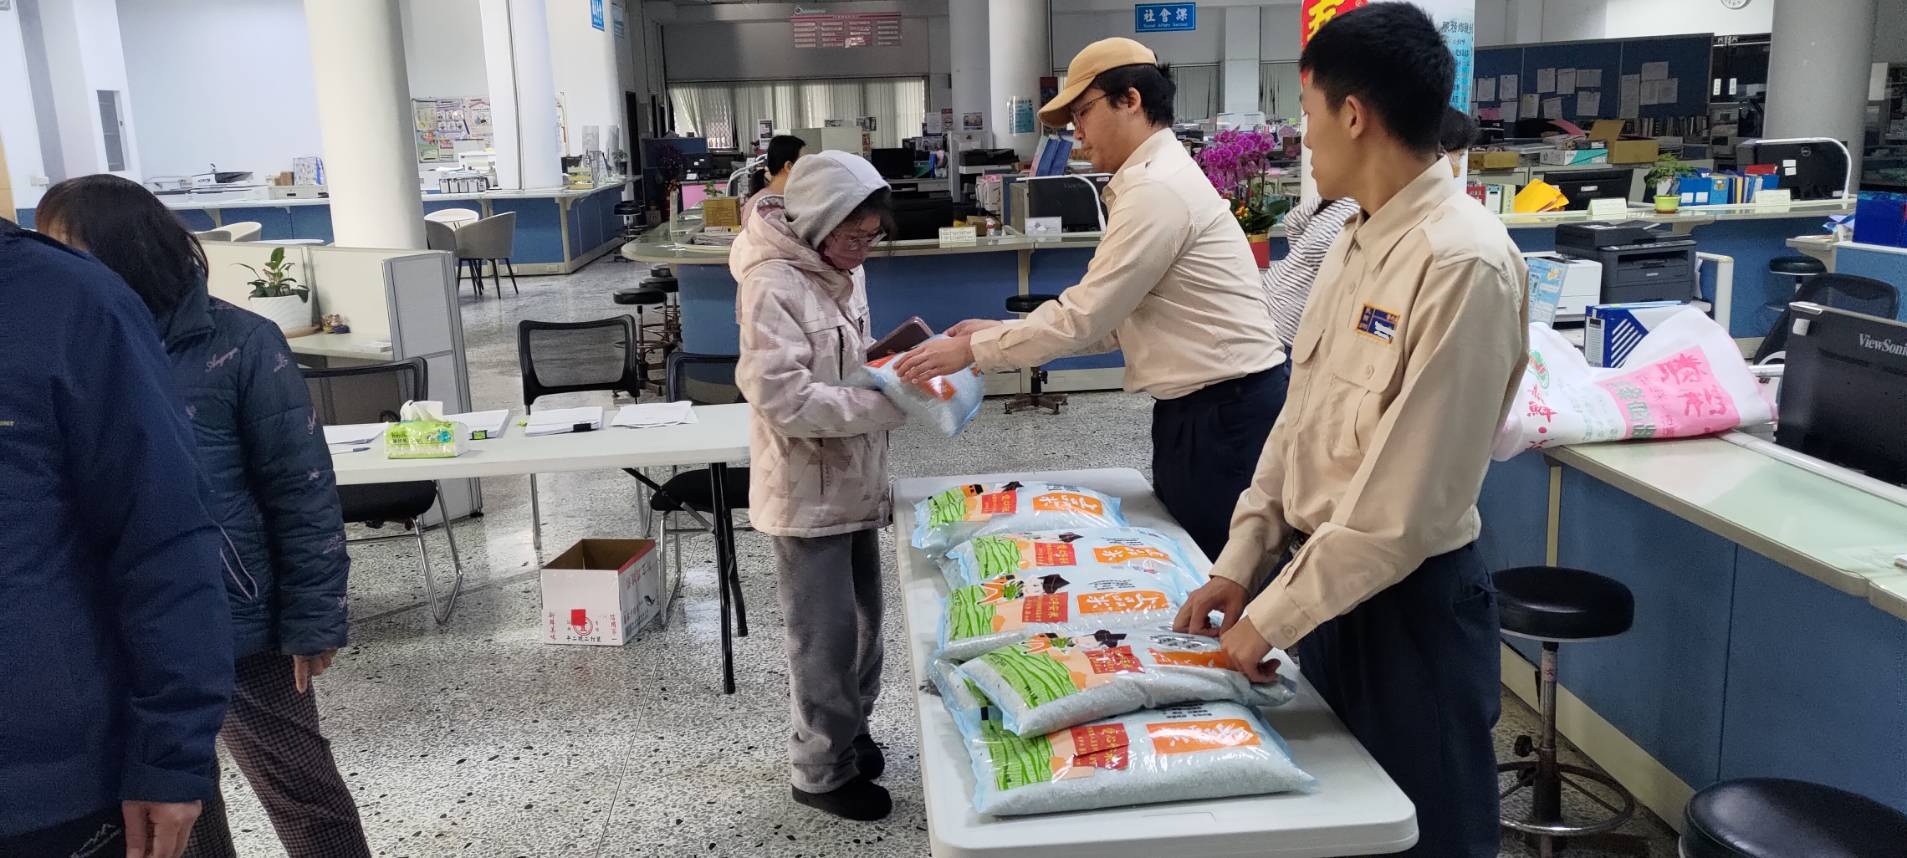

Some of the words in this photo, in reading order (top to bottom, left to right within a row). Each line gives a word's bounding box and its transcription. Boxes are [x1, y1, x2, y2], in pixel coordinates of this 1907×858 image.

[1143, 8, 1188, 22] 社會課
[1860, 333, 1907, 356] ViewSoni
